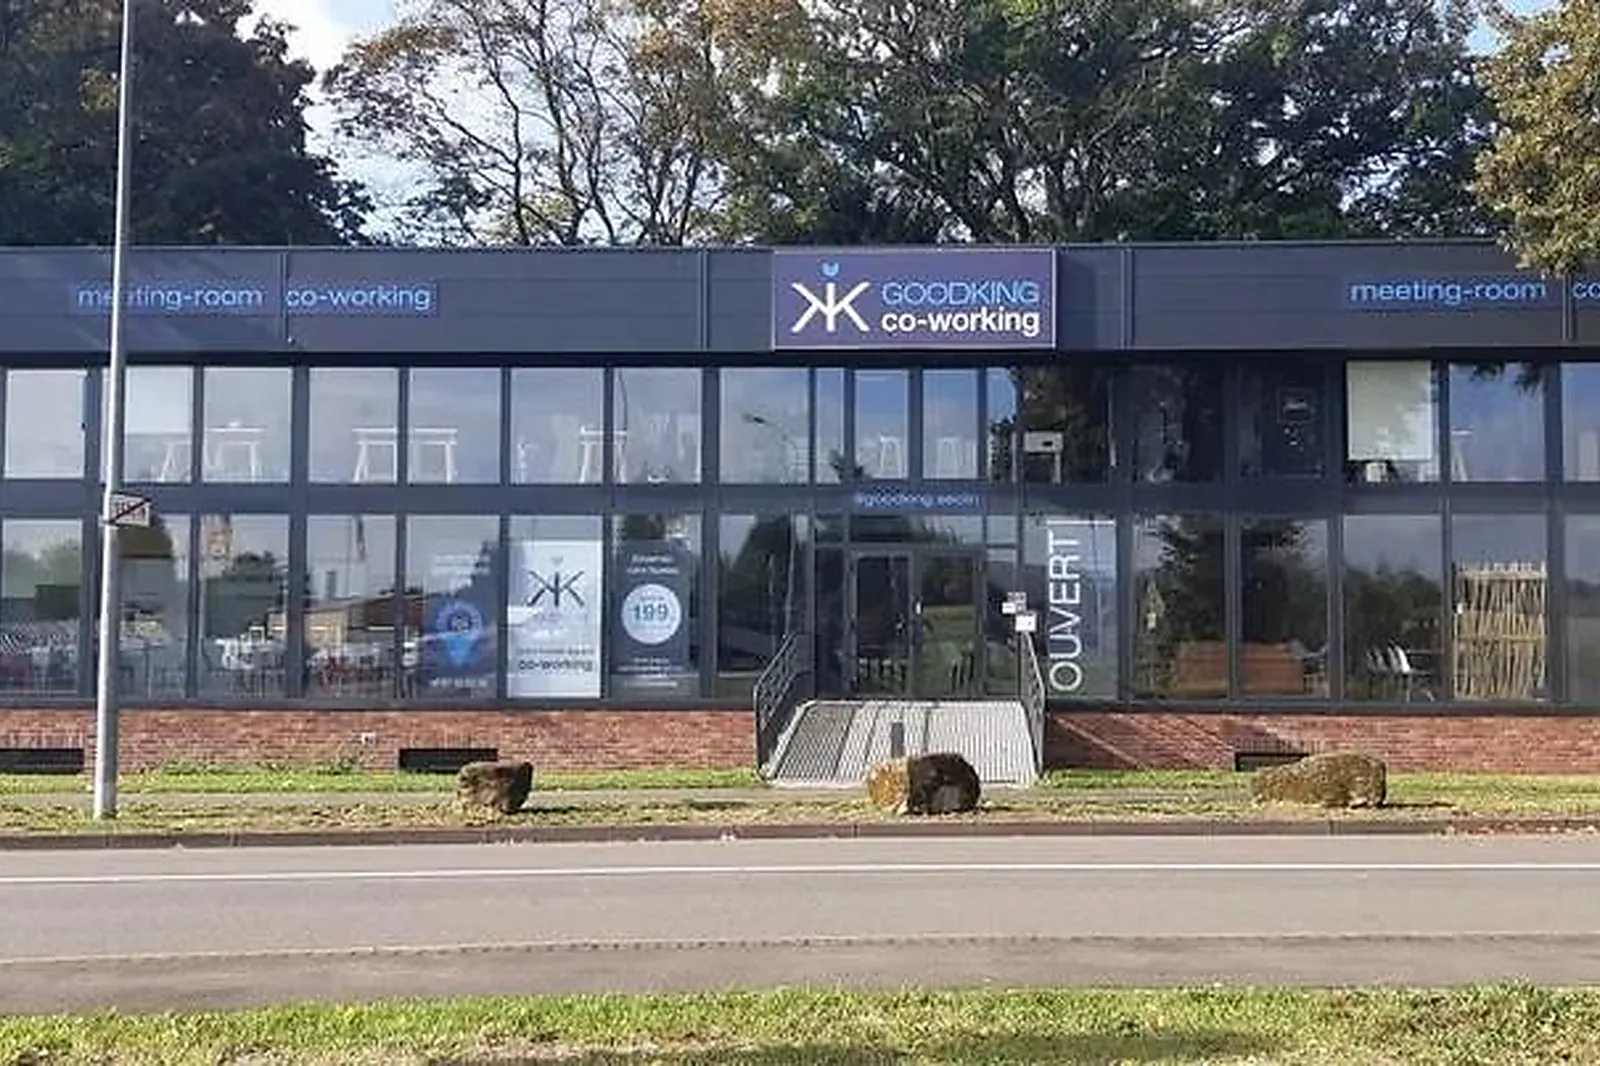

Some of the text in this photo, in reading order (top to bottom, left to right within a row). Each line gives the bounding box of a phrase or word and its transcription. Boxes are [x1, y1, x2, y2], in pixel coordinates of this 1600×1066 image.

[286, 285, 431, 311] co-working
[881, 282, 1040, 305] GOODKING
[1350, 278, 1546, 305] meeting-room
[881, 306, 1041, 337] co-working
[1048, 529, 1082, 692] OUVERT
